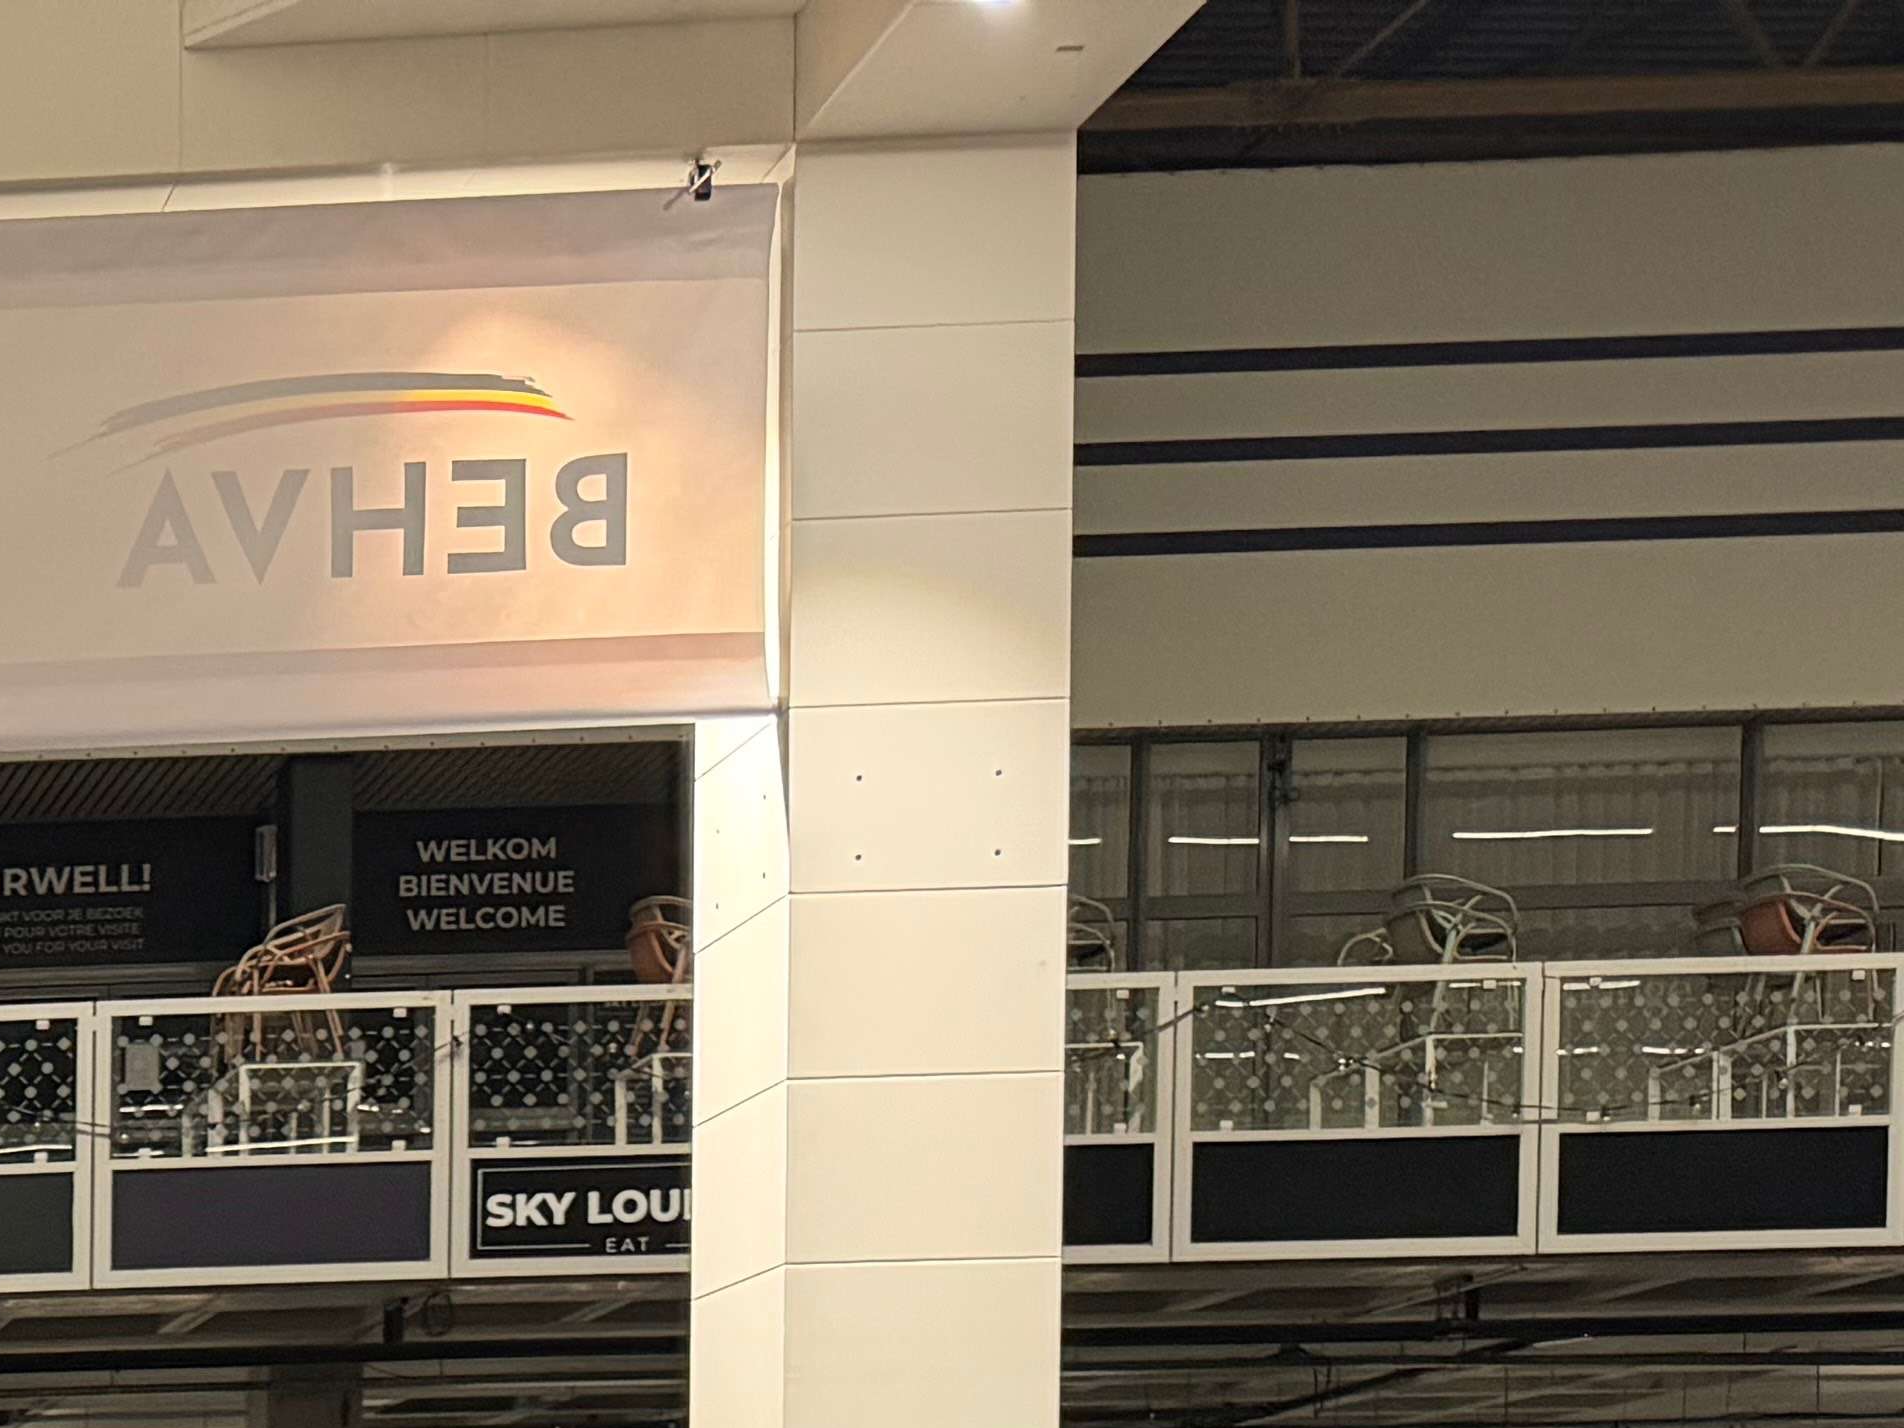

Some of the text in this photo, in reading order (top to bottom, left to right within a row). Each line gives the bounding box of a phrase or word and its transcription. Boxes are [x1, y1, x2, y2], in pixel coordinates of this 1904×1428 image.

[416, 836, 557, 863] WELKOM
[398, 870, 576, 897] BIENVENUE
[406, 905, 567, 931] WELCOME
[485, 1188, 692, 1227] SKY LOU
[605, 1236, 650, 1253] EAT
